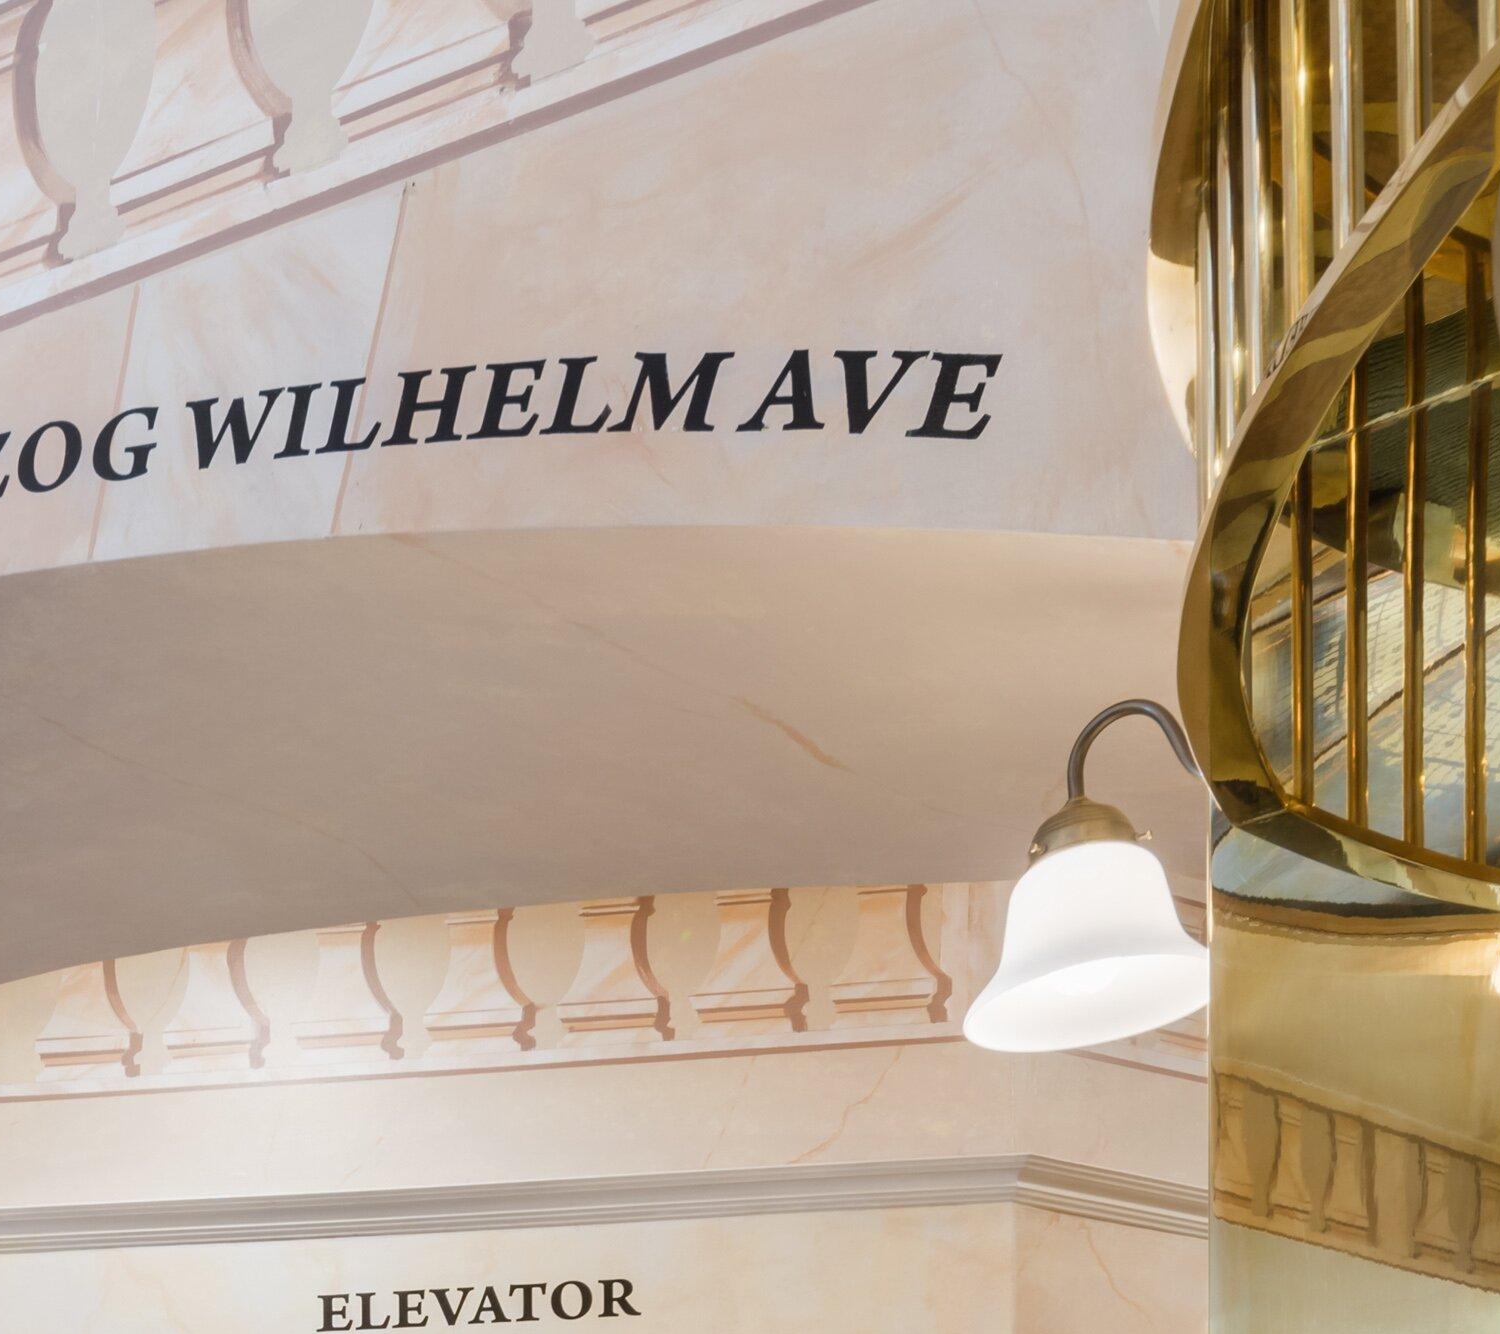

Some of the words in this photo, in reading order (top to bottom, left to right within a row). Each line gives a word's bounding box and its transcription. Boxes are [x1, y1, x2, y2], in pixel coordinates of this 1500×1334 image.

[185, 351, 737, 470] WILHELM
[735, 349, 1003, 440] AVE
[316, 1278, 642, 1333] ELEVATOR
